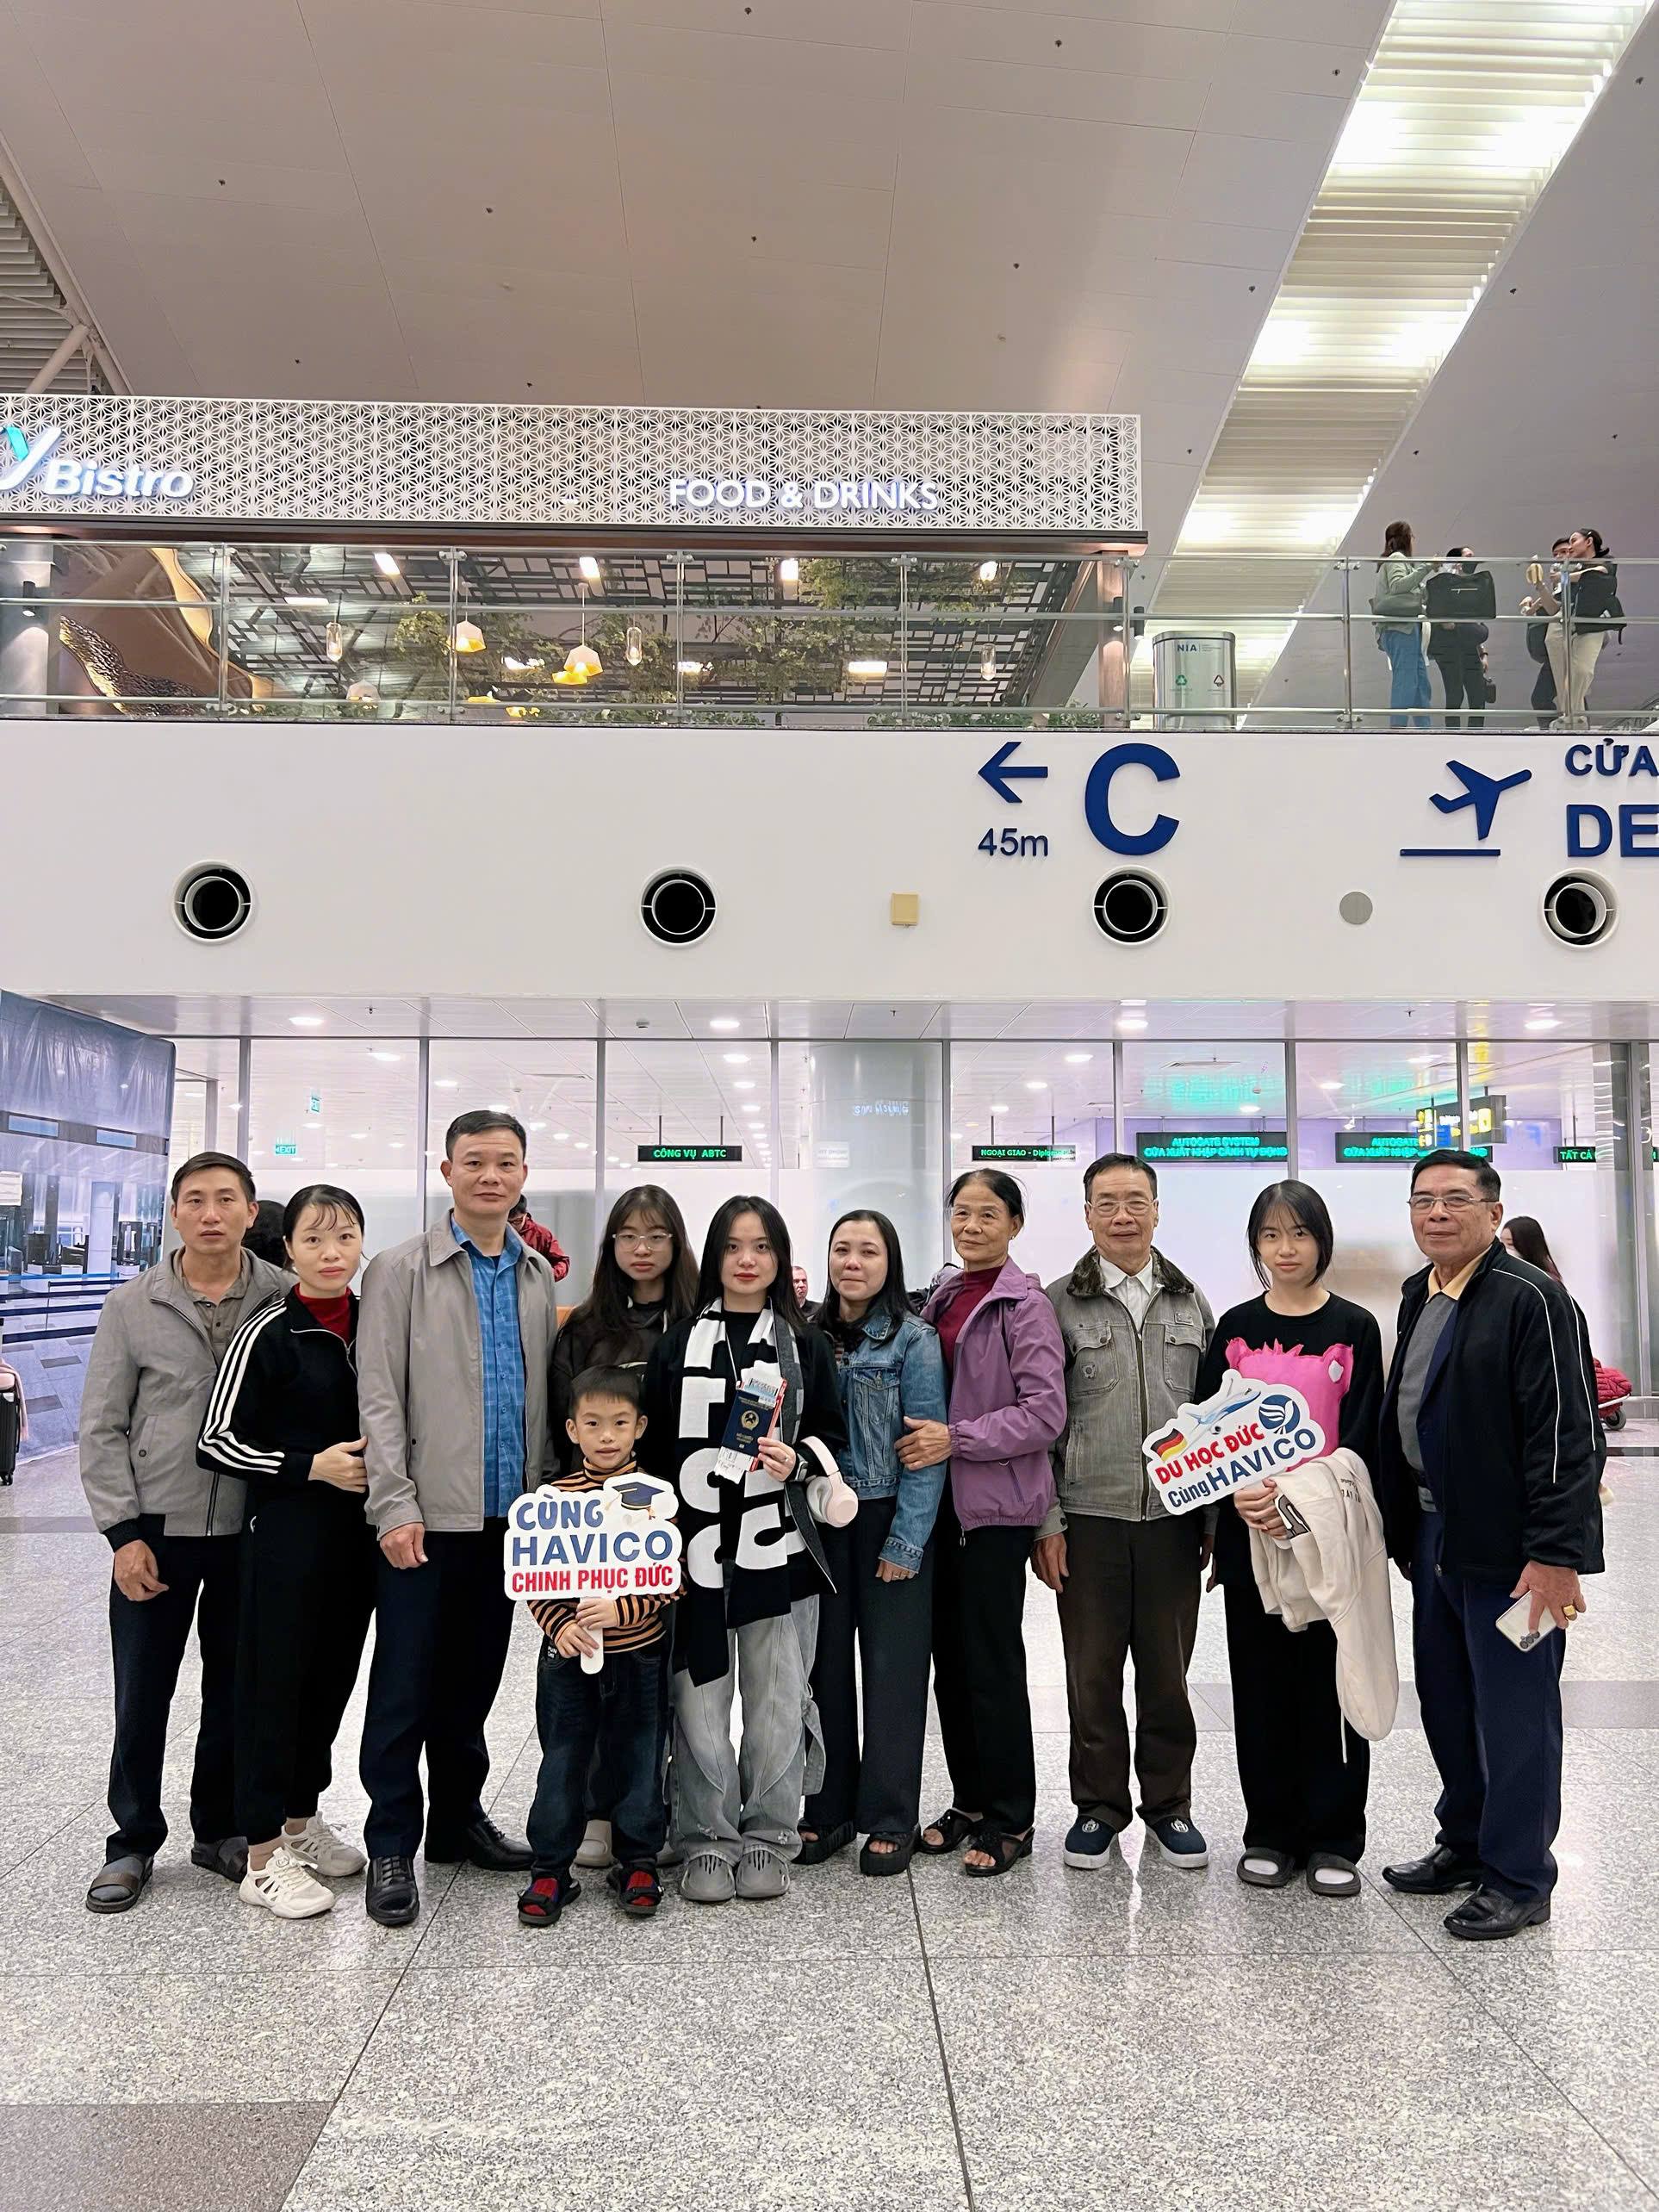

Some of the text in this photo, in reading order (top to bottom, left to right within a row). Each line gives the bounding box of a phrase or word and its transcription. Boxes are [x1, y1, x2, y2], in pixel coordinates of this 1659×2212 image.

[44, 459, 194, 497] Bistro
[669, 479, 937, 510] FOOD & DRINKS
[1565, 737, 1659, 777] CỬA
[1084, 743, 1181, 855] C
[978, 827, 1049, 857] 45m
[1566, 804, 1659, 858] DE
[654, 1148, 727, 1159] CÔNG VỤ ABTC
[980, 1149, 1006, 1158] NGOẠI
[1560, 1149, 1593, 1159] TẤT CẢ
[1154, 1423, 1264, 1485] DU HỌC ĐỨC
[1168, 1480, 1210, 1507] Cùng
[1206, 1428, 1316, 1491] HAVICO
[516, 1493, 604, 1530] CÙNG
[512, 1530, 673, 1566] HAVICO
[512, 1562, 673, 1594] CHINH PHỤC ĐỨC
